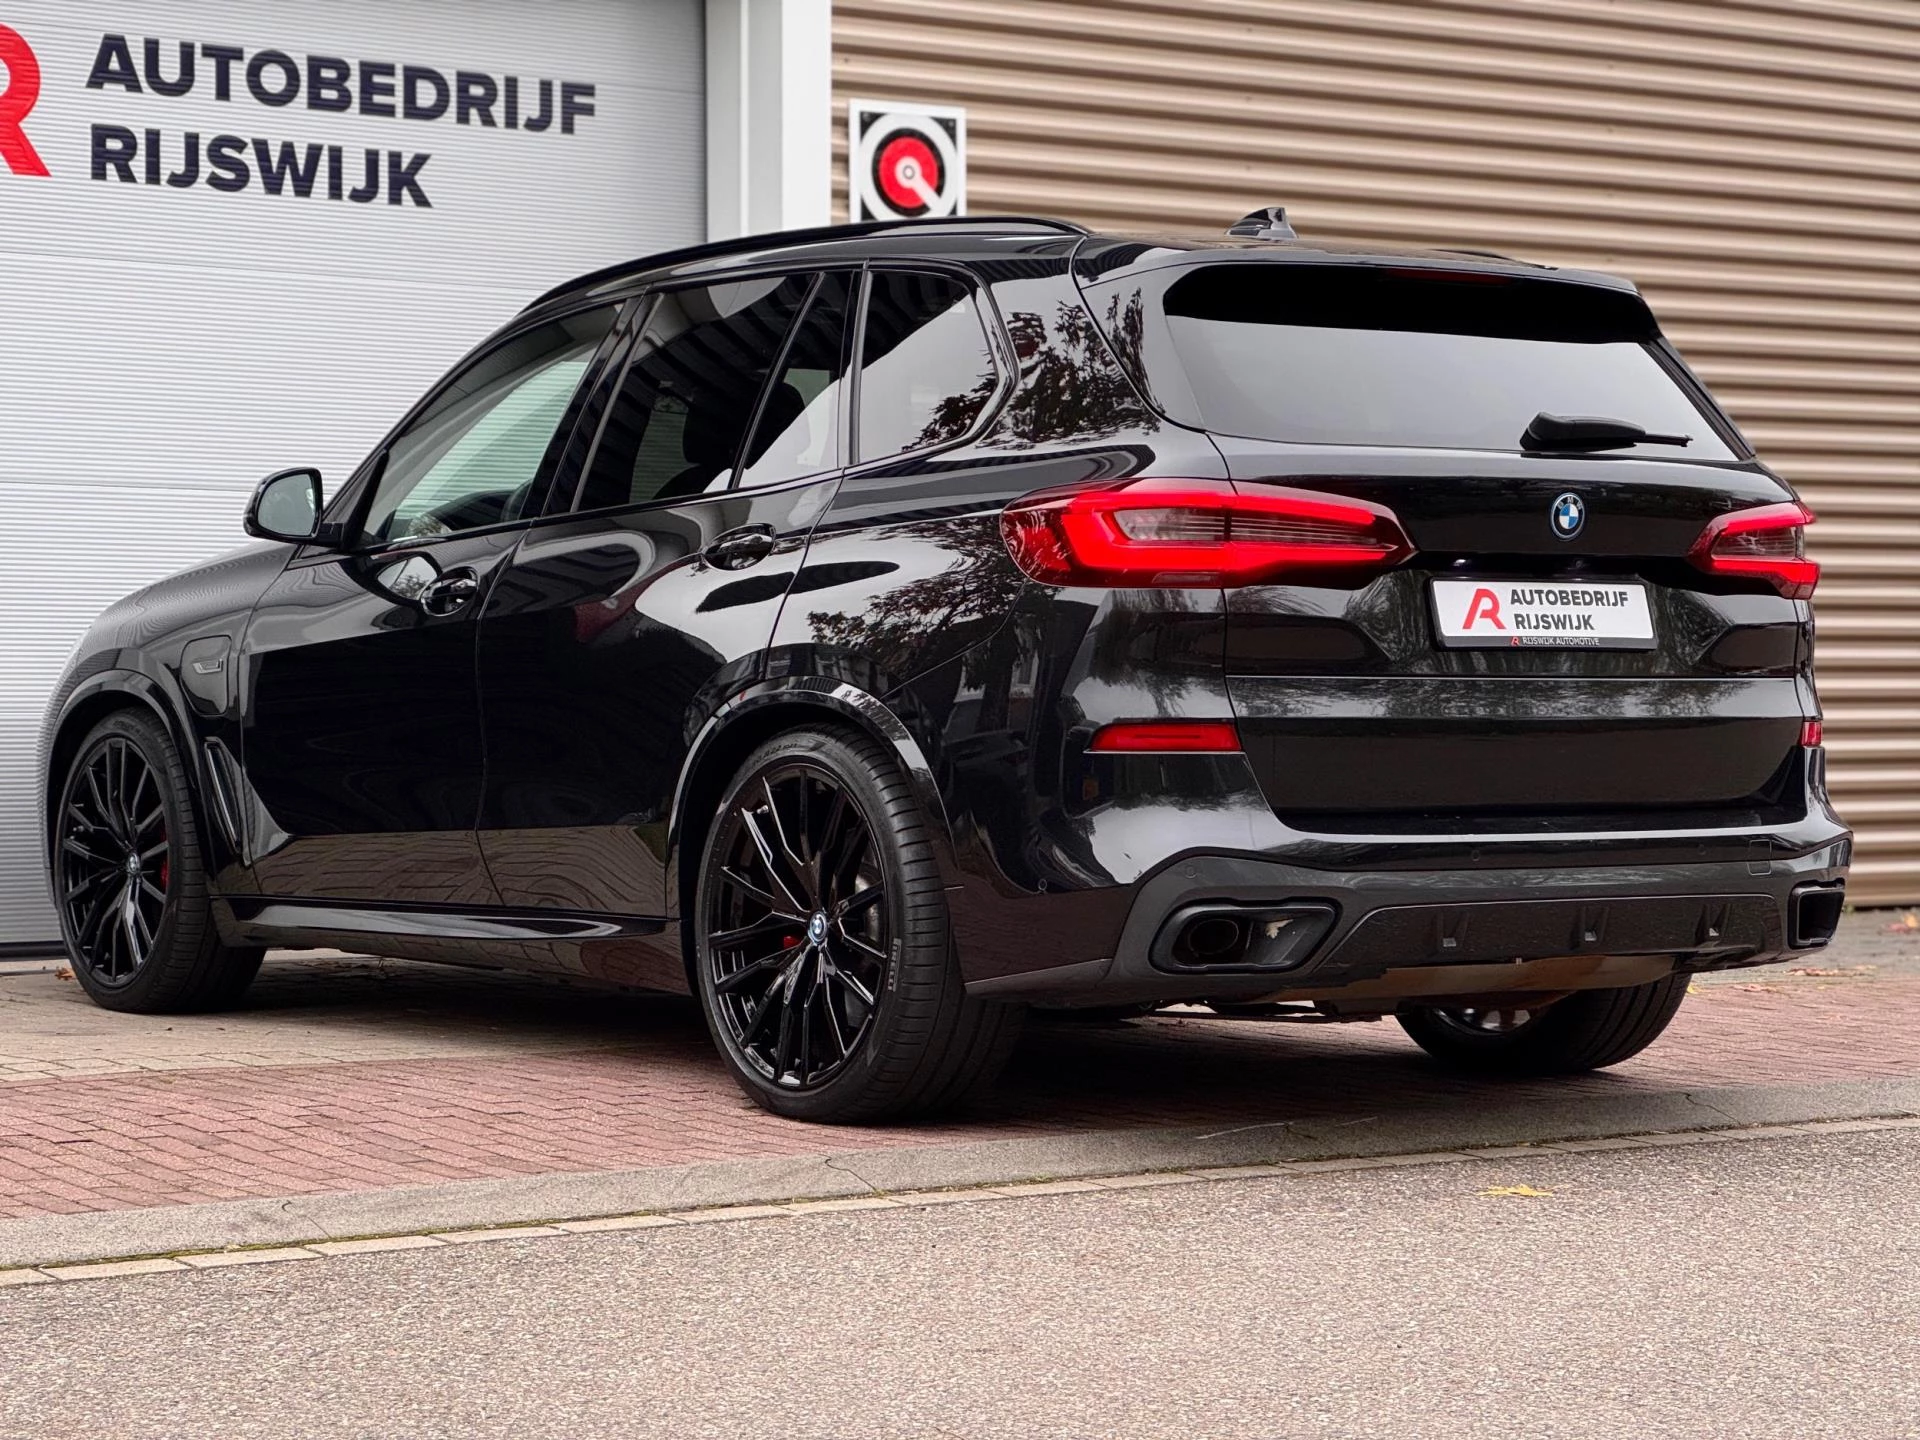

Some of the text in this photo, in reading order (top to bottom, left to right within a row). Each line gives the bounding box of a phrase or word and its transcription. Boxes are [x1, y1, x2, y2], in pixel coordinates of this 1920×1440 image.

[86, 33, 596, 135] AUTOBEDRIJF
[90, 123, 433, 208] RIJSWIJK
[1510, 588, 1629, 607] AUTOBEDRIJF
[1513, 613, 1595, 631] RIJSWIJK
[1522, 636, 1555, 646] RIJSWIJK
[1556, 637, 1600, 646] AUTOMOTIVE
